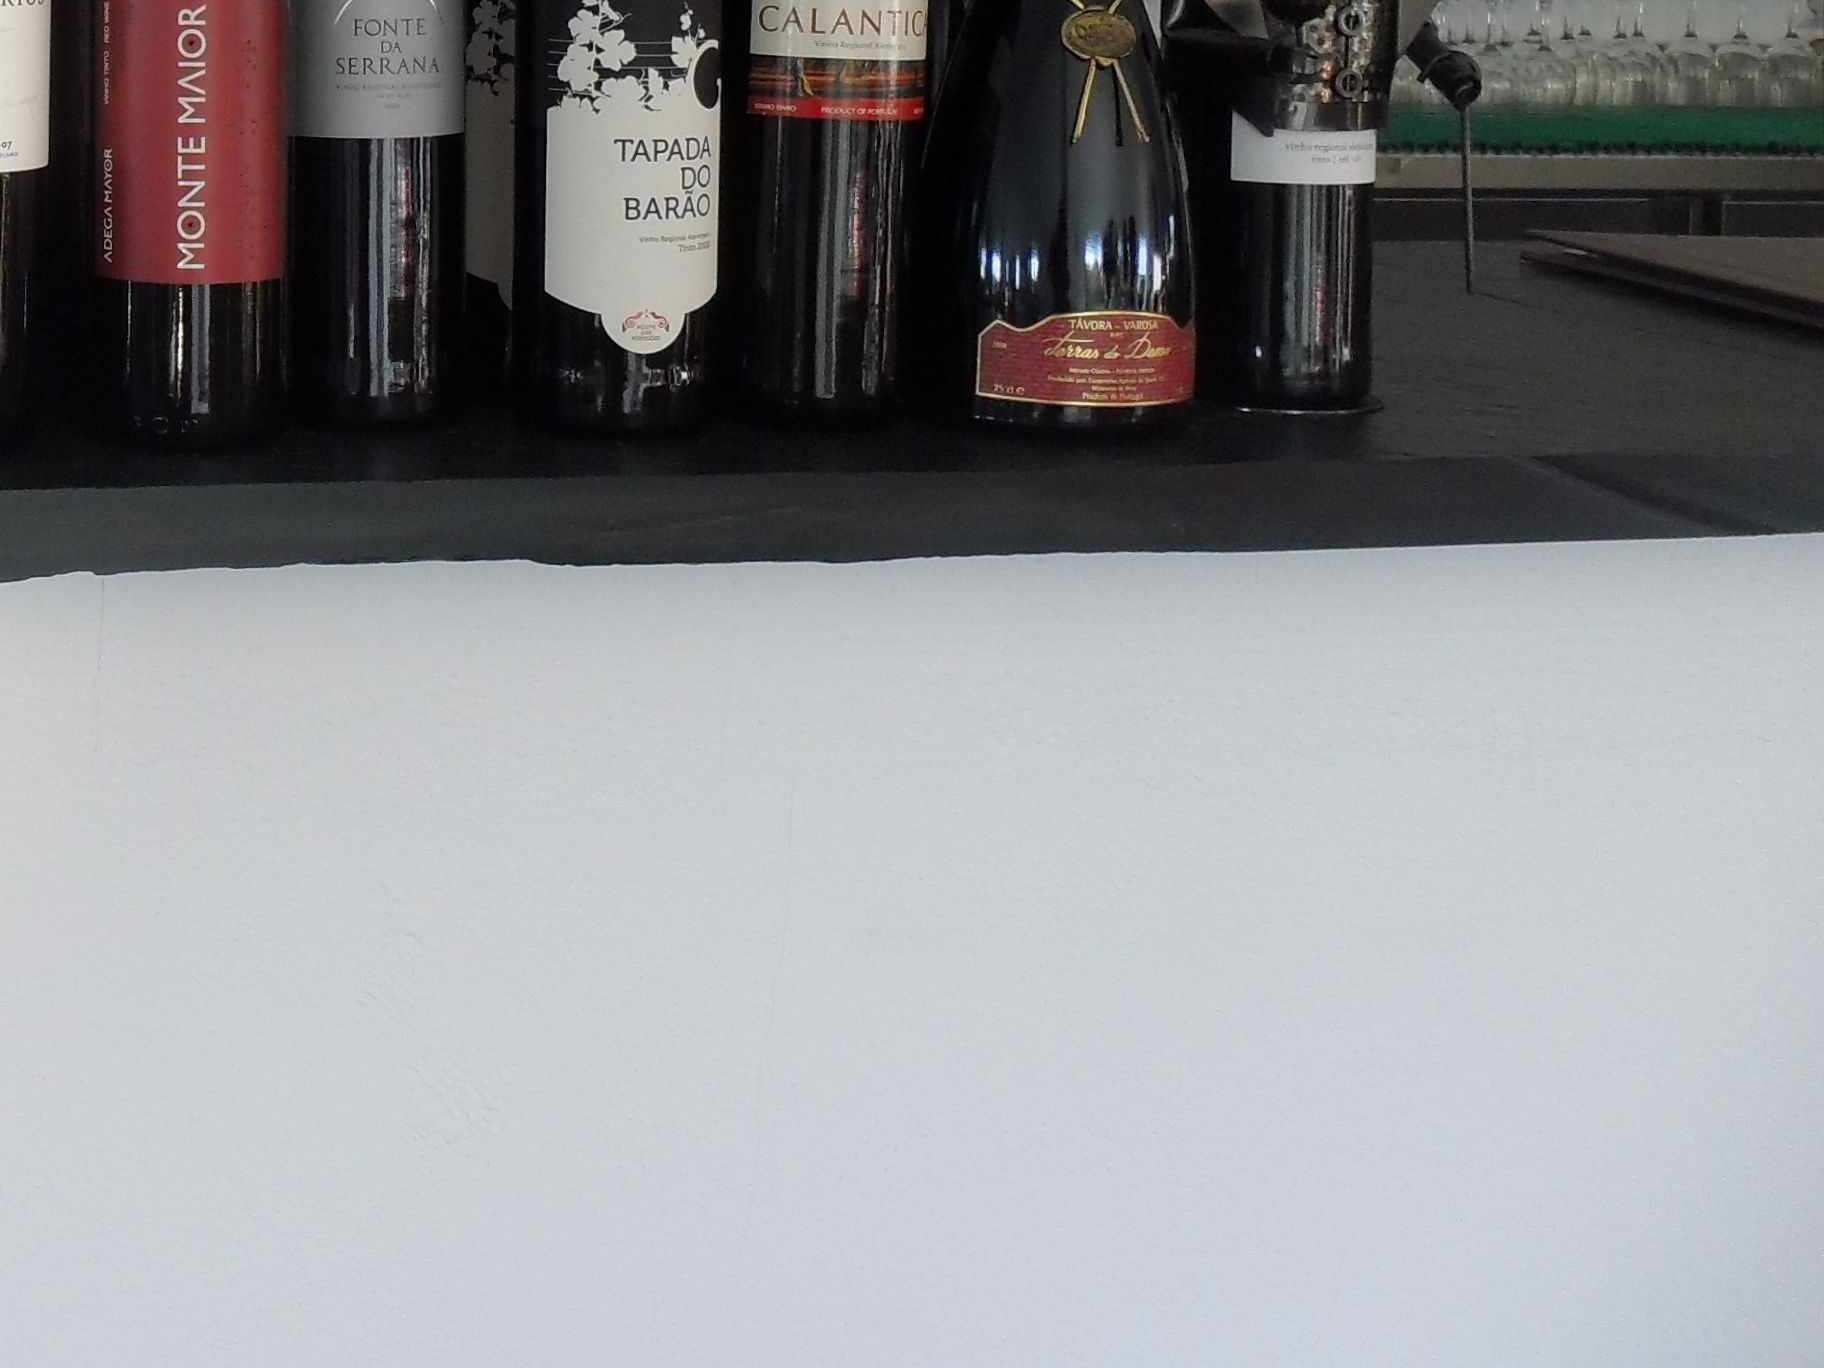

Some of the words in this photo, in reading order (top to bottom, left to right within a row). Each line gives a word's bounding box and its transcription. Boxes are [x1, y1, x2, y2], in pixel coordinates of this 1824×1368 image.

[353, 18, 427, 37] FONTE
[380, 40, 403, 54] DA
[335, 56, 440, 75] SERRANA
[613, 136, 711, 163] TAPADA
[103, 148, 113, 203] MAYOR
[680, 164, 711, 190] DO
[176, 136, 207, 269] MONTE
[623, 190, 711, 221] BARÃO
[103, 206, 113, 263] ADEGA
[1068, 317, 1113, 331] TÁVORA
[1123, 319, 1158, 330] VAROSA
[1042, 331, 1100, 359] Terras
